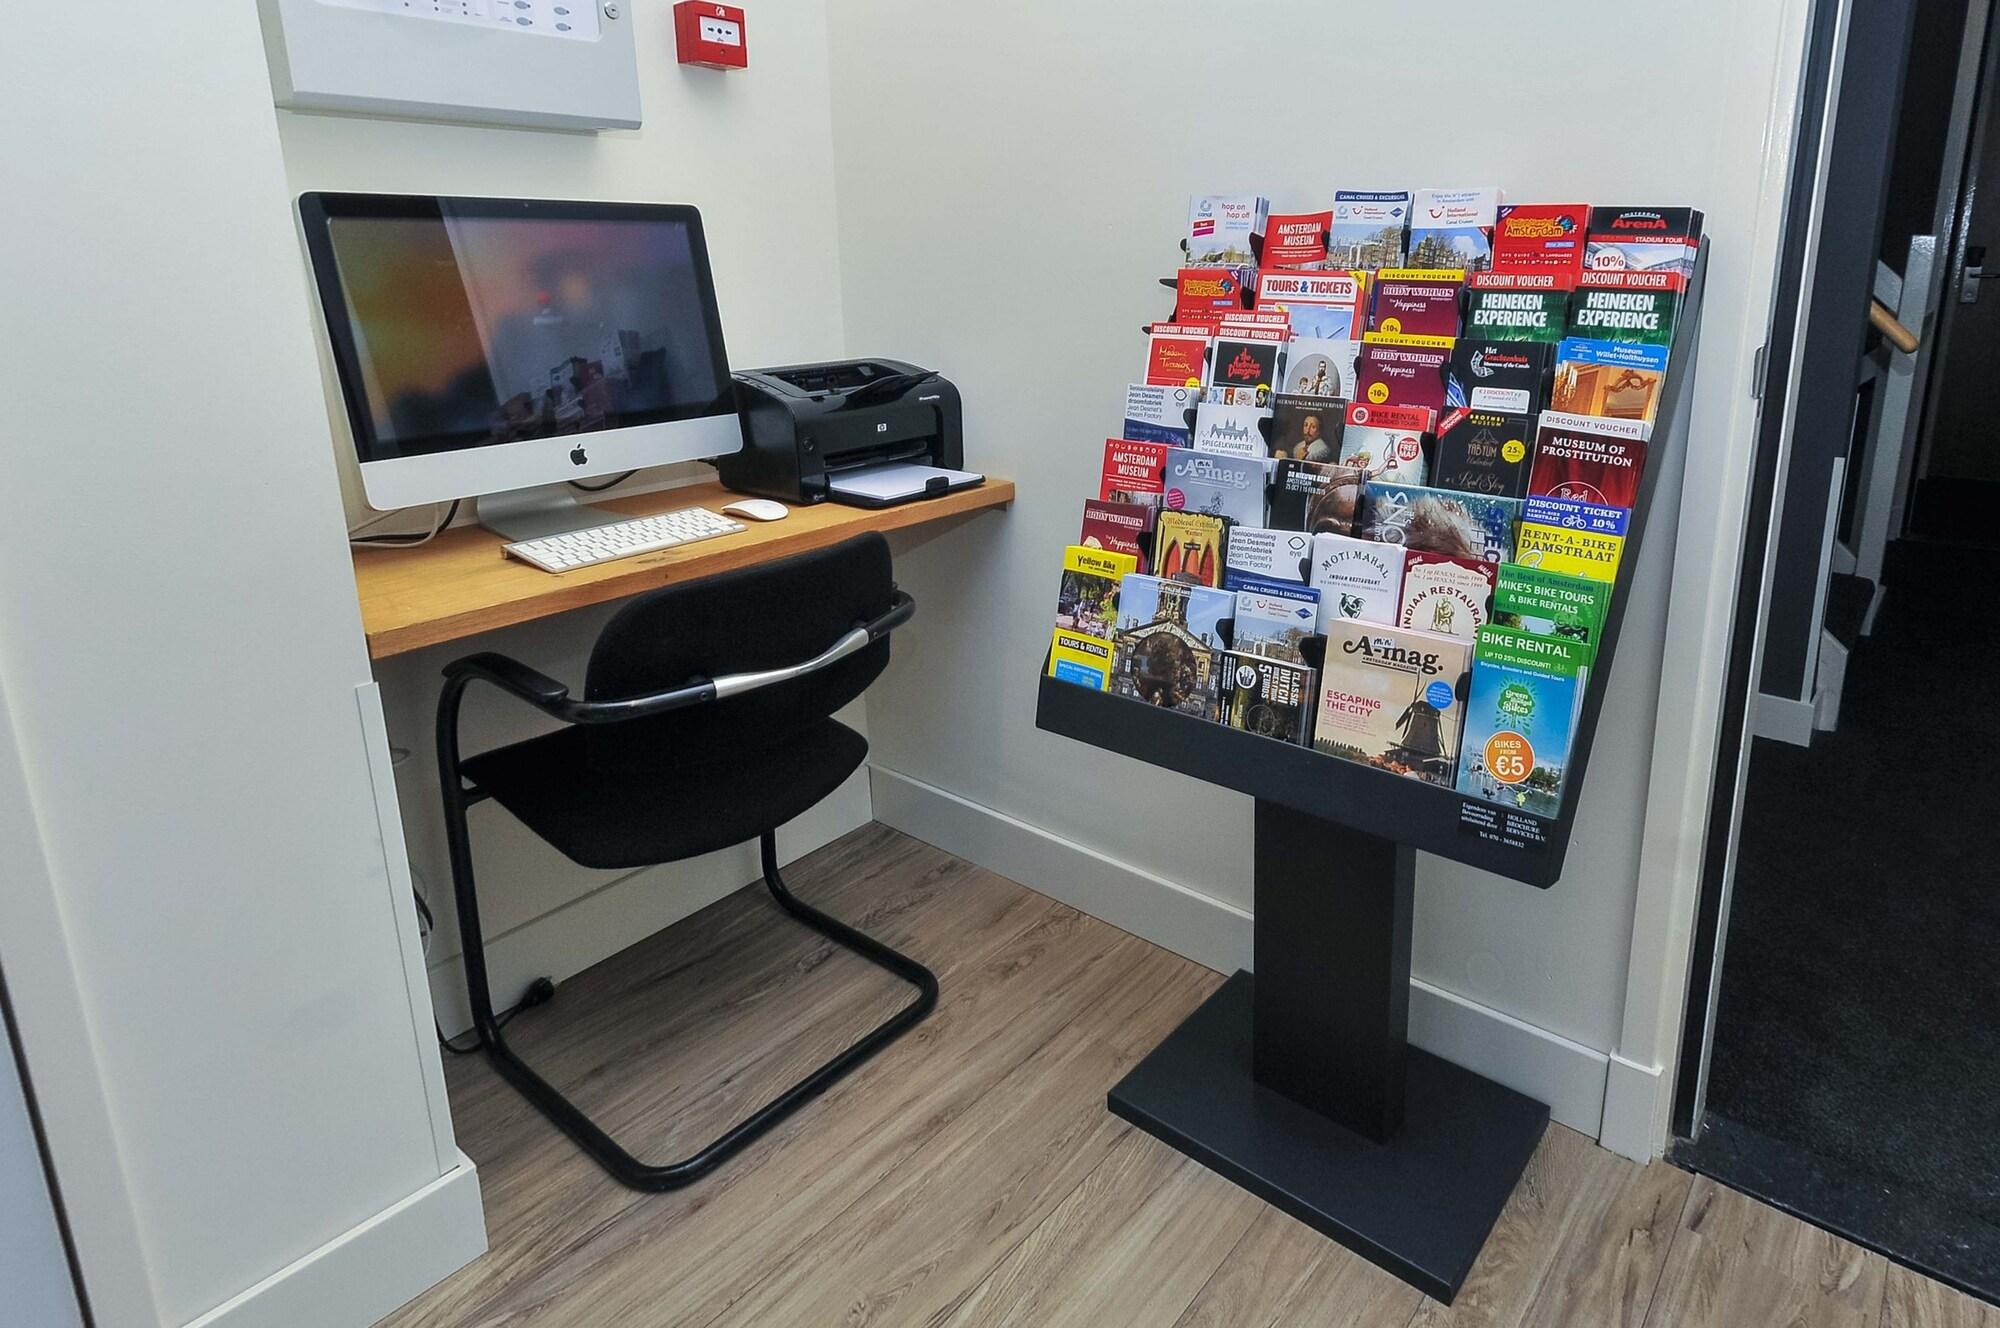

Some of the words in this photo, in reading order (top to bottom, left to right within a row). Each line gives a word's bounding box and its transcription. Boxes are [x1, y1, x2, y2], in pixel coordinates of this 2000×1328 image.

[1278, 222, 1321, 234] AMSTERDAM
[1506, 227, 1562, 235] Amsterdam
[1283, 235, 1314, 245] MUSEUM
[1595, 256, 1624, 267] 10%
[1477, 274, 1515, 286] DISCOUNT
[1517, 275, 1554, 287] VOUCHER
[1582, 272, 1625, 285] DISCOUNT
[1627, 274, 1667, 286] VOUCHER
[1267, 280, 1299, 292] TOURS
[1300, 281, 1308, 292] &
[1310, 281, 1352, 294] TICKETS
[1482, 293, 1543, 310] HEINEKEN
[1587, 292, 1656, 311] HEINEKEN
[1474, 310, 1548, 326] EXPERIENCE
[1577, 309, 1659, 329] EXPERIENCE
[1220, 328, 1250, 337] DISCOUNT
[1251, 330, 1280, 339] VOUCHER
[1614, 346, 1643, 354] Museum
[1596, 351, 1659, 364] Willet-Holthuysen
[1391, 412, 1419, 420] RENTAL
[1547, 416, 1590, 428] DISCOUNT
[1594, 423, 1638, 434] VOUCHER
[1202, 440, 1253, 451] SPIEGELKWARTIER
[1400, 444, 1417, 452] FREE
[1552, 437, 1605, 452] MUSEUM
[1609, 445, 1626, 456] OF
[1113, 451, 1157, 467] AMSTERDAM
[1542, 446, 1632, 467] PROSTITUTION
[1118, 464, 1149, 478] MUSEUM
[1561, 488, 1588, 503] Red
[1529, 499, 1580, 513] DISCOUNT
[1583, 507, 1622, 519] TICKET
[1527, 513, 1560, 521] DAMSTRAAT
[1592, 519, 1616, 529] 10%
[1230, 544, 1272, 554] droomfabriek
[1247, 538, 1275, 547] Desmets
[1521, 539, 1615, 562] DAMSTRAAT
[1077, 555, 1101, 567] Yellow
[1103, 560, 1116, 570] Bike
[1229, 558, 1248, 566] Dream
[1249, 560, 1272, 570] Factory
[1322, 551, 1350, 571] MOTI
[1353, 551, 1390, 579] MAHAL
[1349, 577, 1381, 585] RESTAURANT
[1243, 584, 1259, 592] CANAL
[1284, 591, 1313, 600] EXCURSIONS
[1498, 580, 1532, 593] MIKE'S
[1534, 585, 1557, 598] BIKE
[1559, 590, 1594, 605] TOURS
[1404, 591, 1427, 629] INDIAN
[1509, 594, 1515, 602] &
[1518, 596, 1538, 607] BIKE
[1540, 600, 1578, 614] RENTALS
[1060, 638, 1080, 648] TOURS
[1086, 644, 1107, 656] RENTALS
[1482, 632, 1513, 647] BIKE
[1517, 638, 1571, 658] RENTAL
[1343, 636, 1443, 675] A-mag.
[1363, 656, 1391, 666] AMSTERDAM
[1258, 664, 1272, 673] 5
[1517, 657, 1551, 669] DISCOUNT!
[1278, 668, 1291, 704] DUTCH
[1290, 672, 1300, 707] CLASSIC
[1327, 690, 1381, 709] ESCAPING
[1506, 690, 1528, 700] green
[1326, 699, 1346, 711] THE
[1348, 705, 1372, 717] CITY
[1494, 740, 1521, 748] BIKES
[1496, 755, 1525, 776] €5
[1507, 821, 1540, 833] BROCHURE
[1508, 814, 1537, 826] HOLLAND
[1506, 827, 1534, 839] SERVICES
